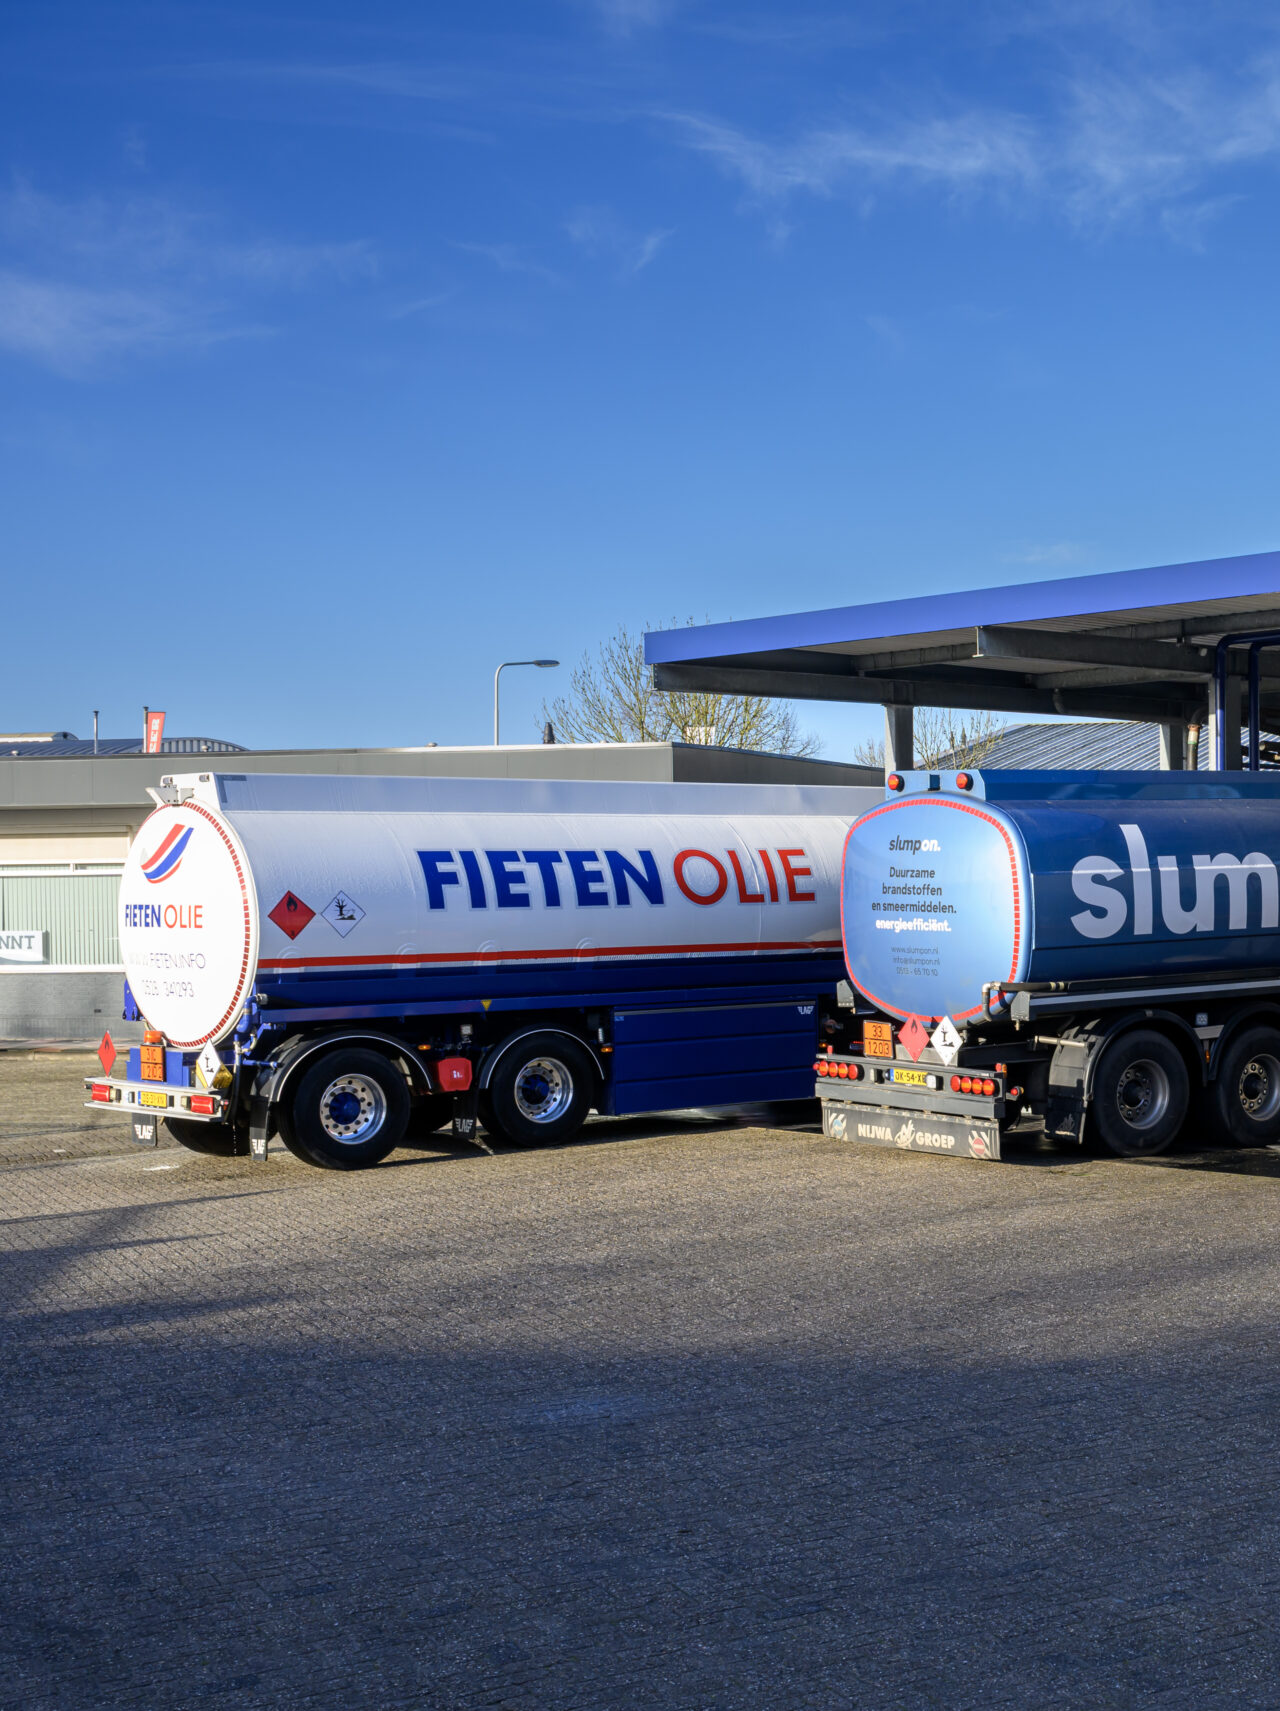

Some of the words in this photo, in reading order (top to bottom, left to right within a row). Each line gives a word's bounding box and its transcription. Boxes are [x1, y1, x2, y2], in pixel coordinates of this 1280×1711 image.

[889, 835, 941, 855] slumpon.
[889, 866, 936, 878] Duurzame
[882, 882, 942, 896] brandstoffen
[871, 901, 881, 912] en
[882, 900, 957, 913] smeermiddelen.
[875, 917, 952, 933] energieefficiënt.
[872, 1025, 882, 1038] 33
[868, 1041, 890, 1055] 1203
[915, 1131, 955, 1149] GROEP
